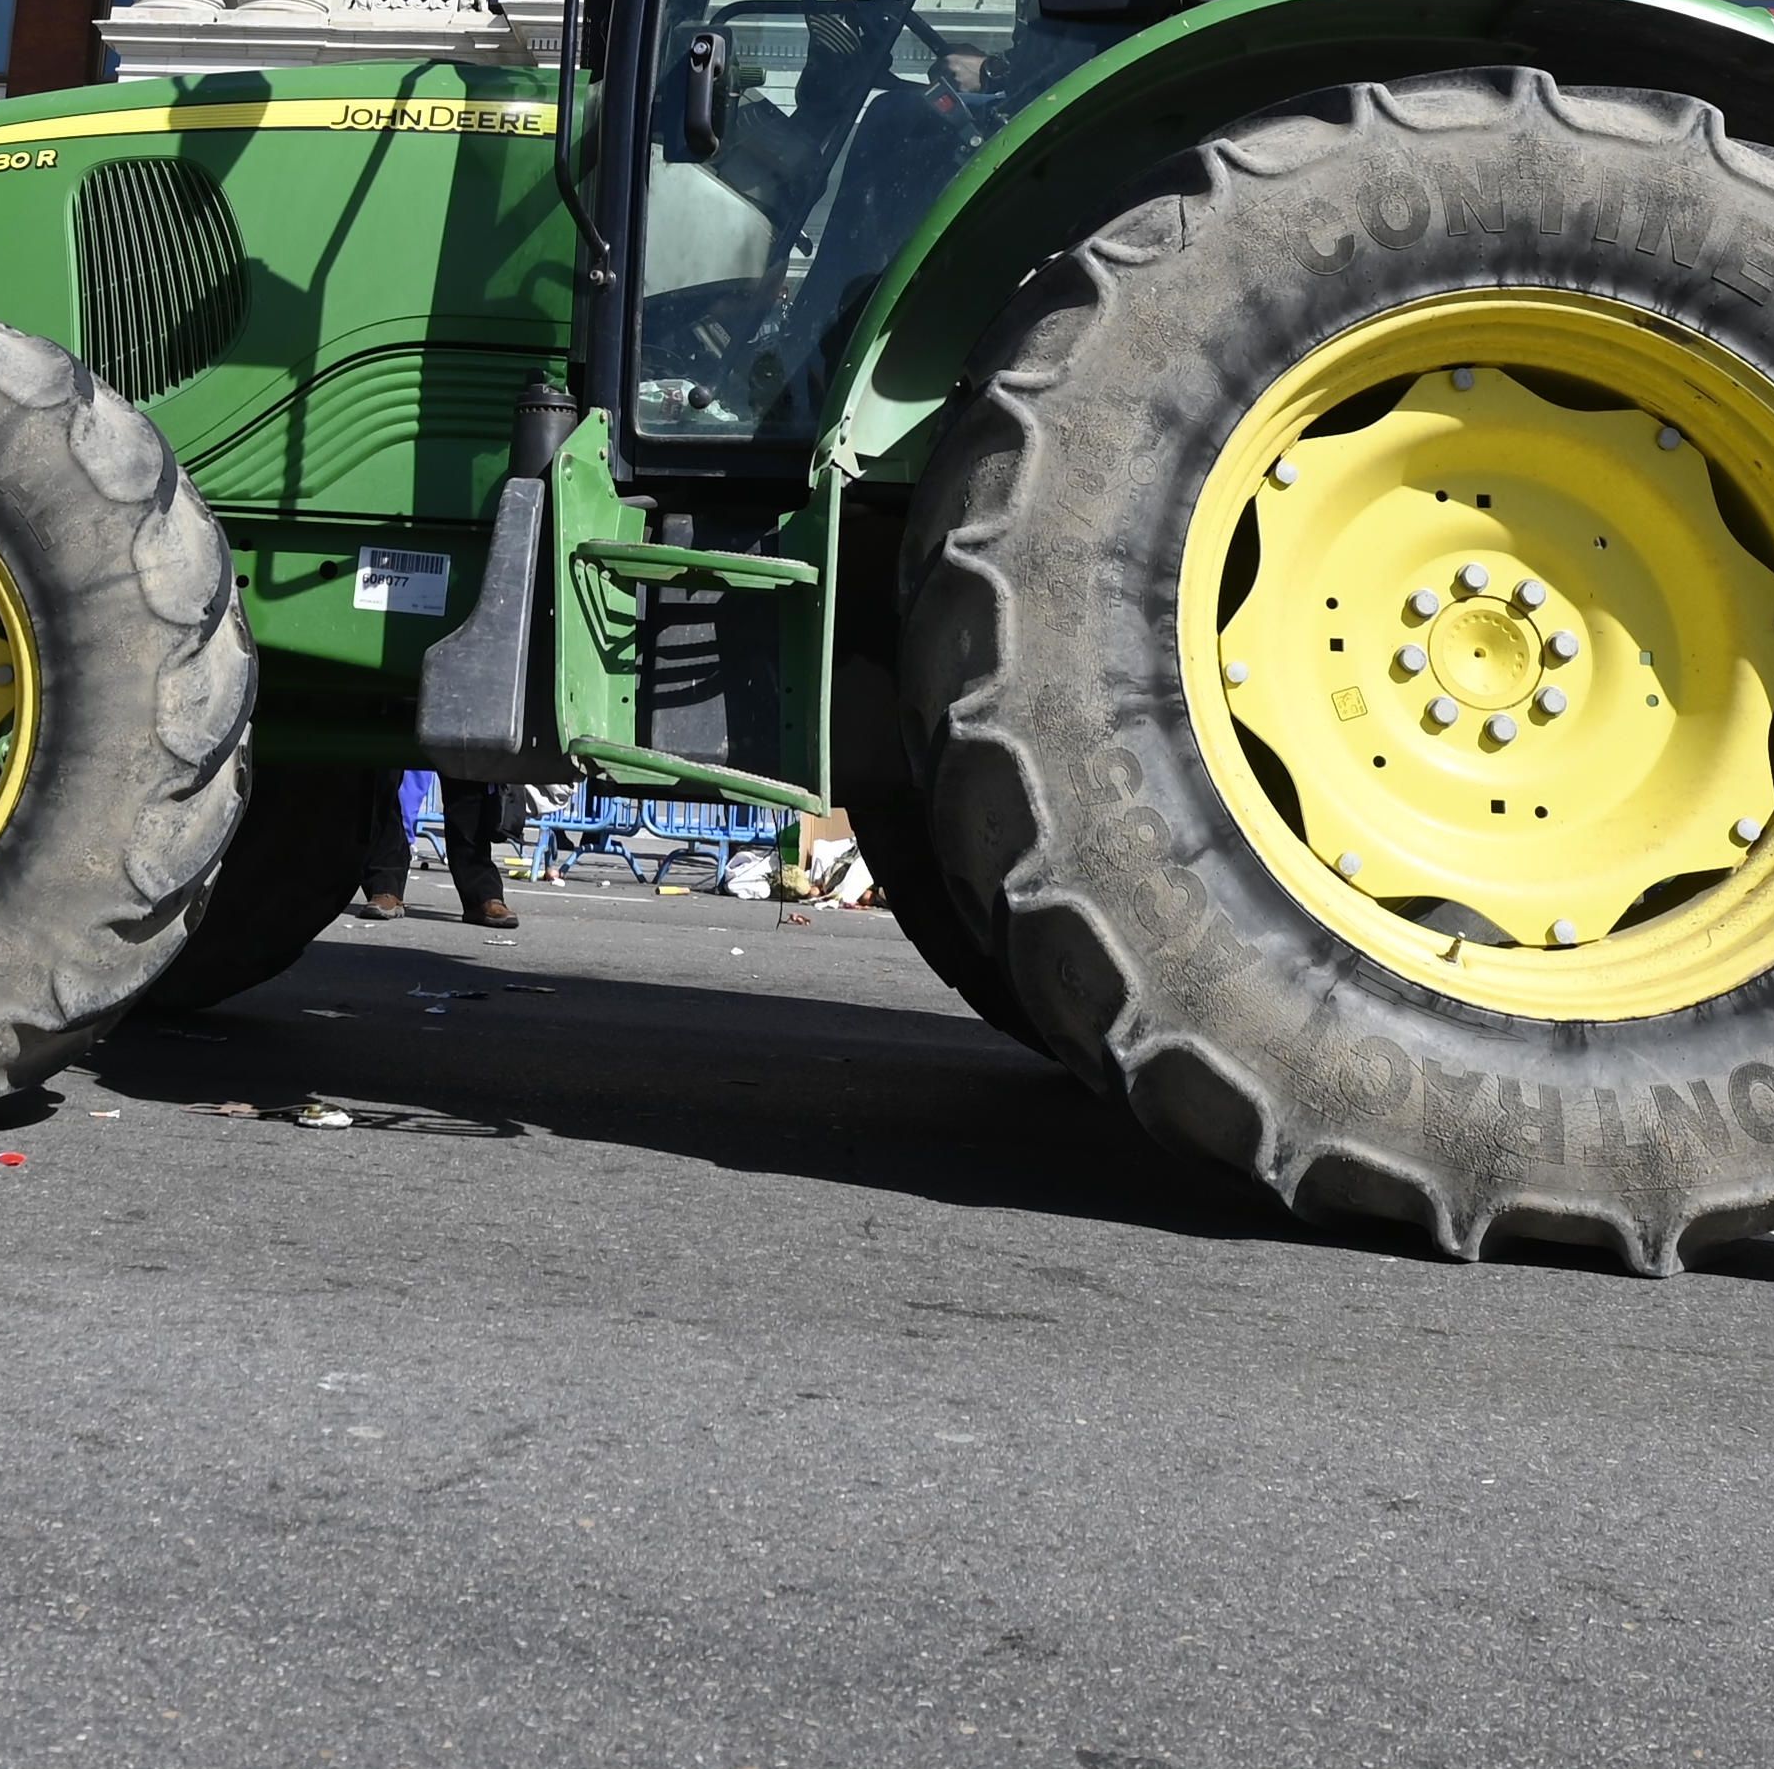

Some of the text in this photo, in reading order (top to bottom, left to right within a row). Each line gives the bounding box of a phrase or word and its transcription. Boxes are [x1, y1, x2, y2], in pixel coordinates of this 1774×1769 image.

[331, 105, 543, 132] JOHN DEERE
[36, 149, 58, 168] R
[362, 573, 410, 588] 608077
